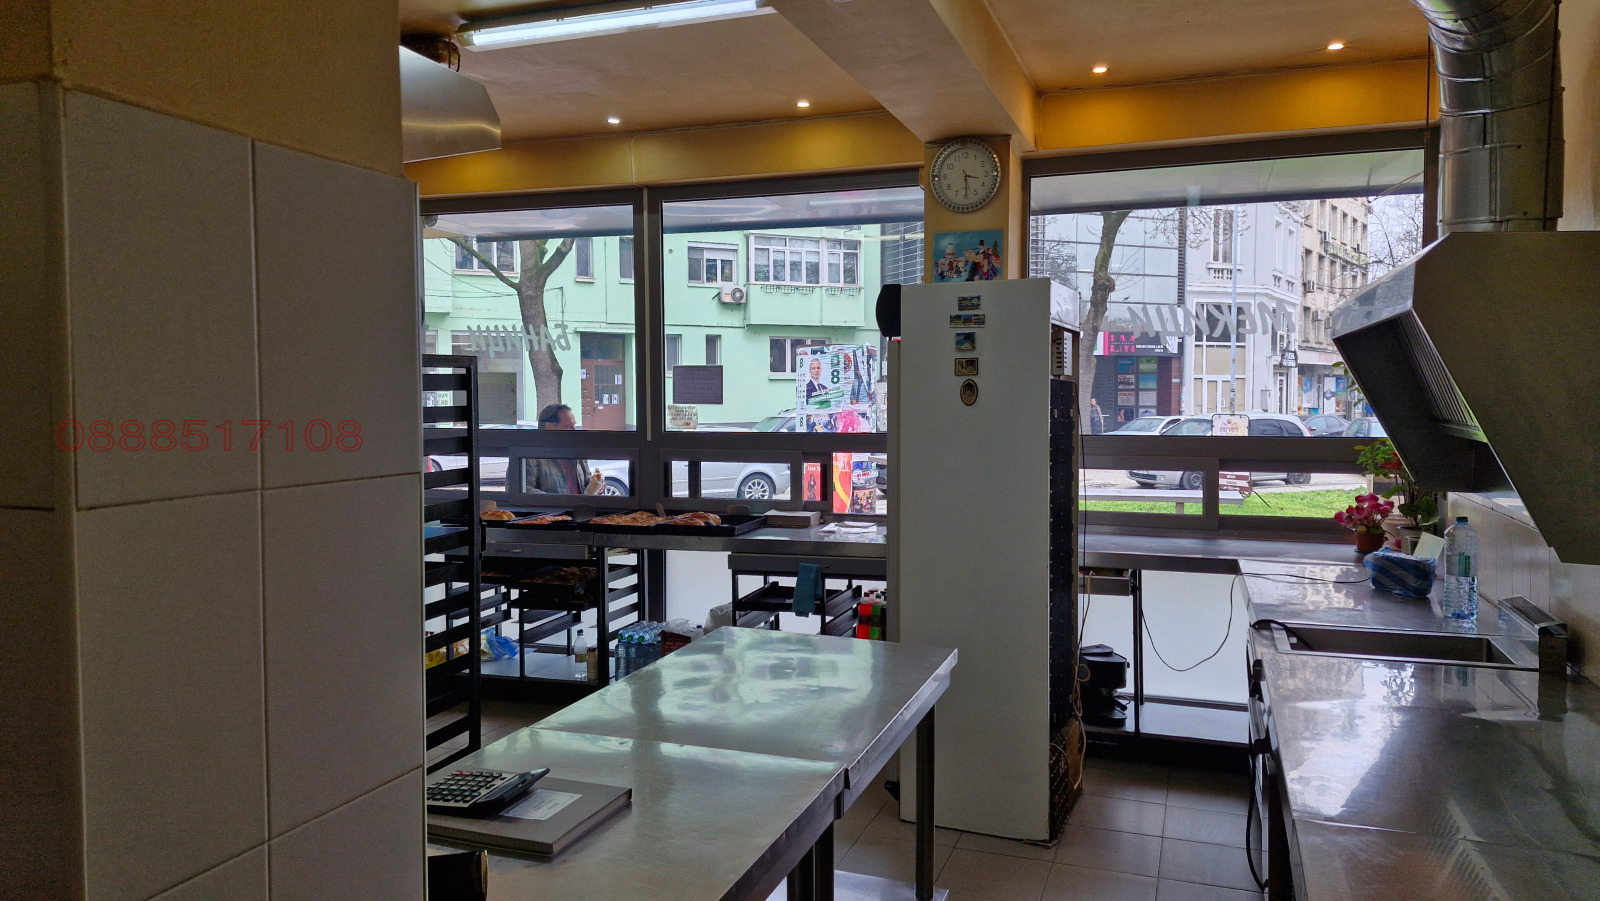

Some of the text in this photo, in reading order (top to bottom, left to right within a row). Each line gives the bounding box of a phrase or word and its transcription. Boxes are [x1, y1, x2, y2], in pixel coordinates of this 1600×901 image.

[799, 358, 804, 368] 8
[831, 369, 840, 384] 8
[799, 417, 804, 427] 8
